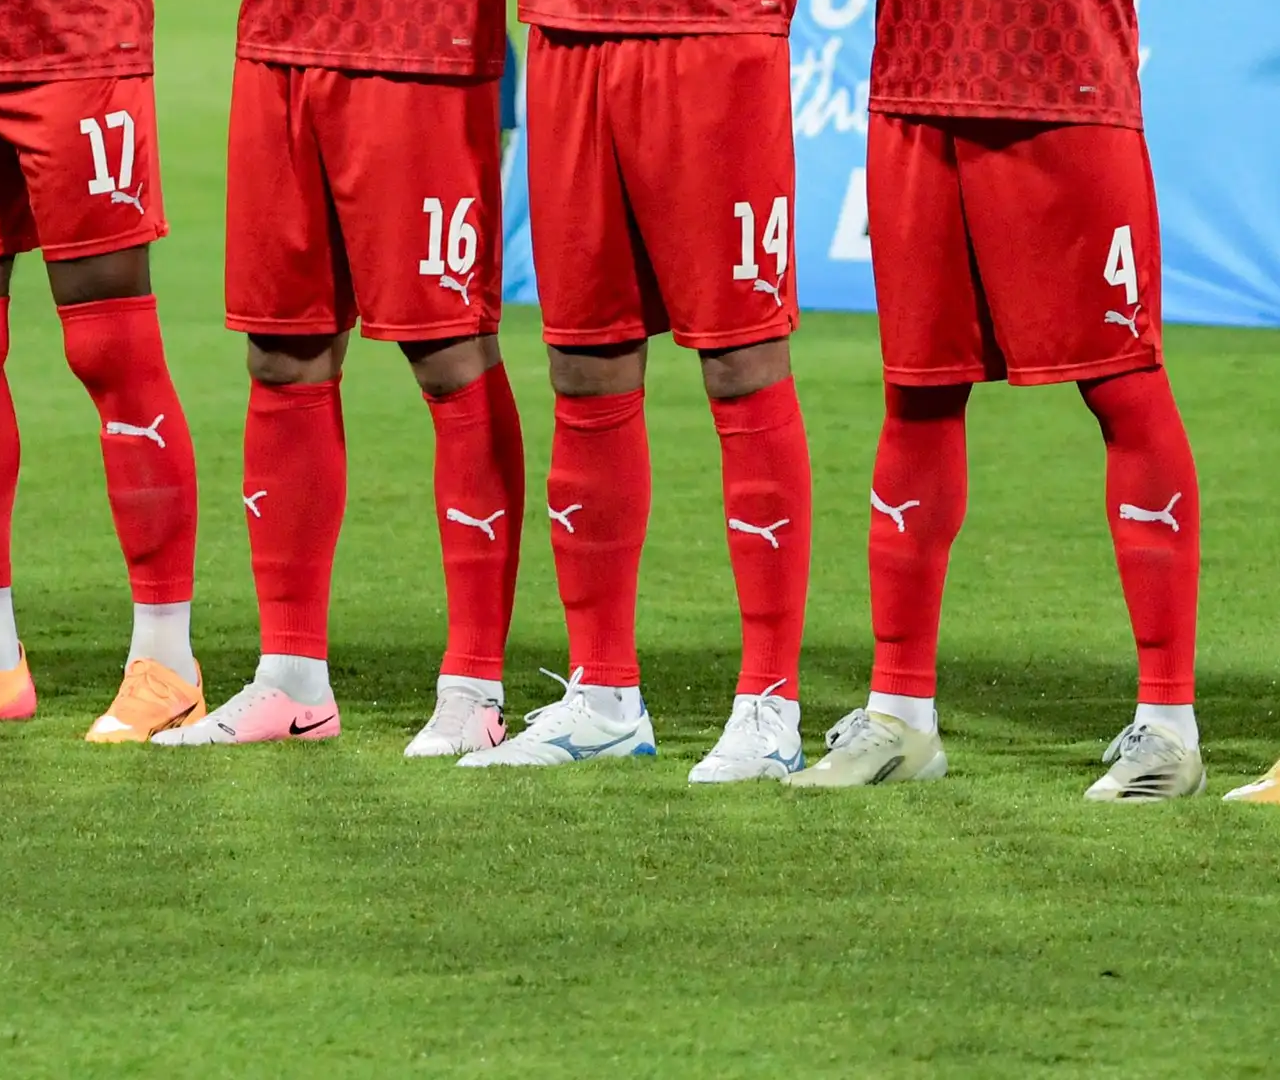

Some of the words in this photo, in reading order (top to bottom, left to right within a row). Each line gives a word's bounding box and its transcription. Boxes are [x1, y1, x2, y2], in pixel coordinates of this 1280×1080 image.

[79, 110, 135, 195] 17
[419, 197, 477, 275] 16
[733, 196, 789, 280] 14
[1103, 224, 1138, 305] 4
